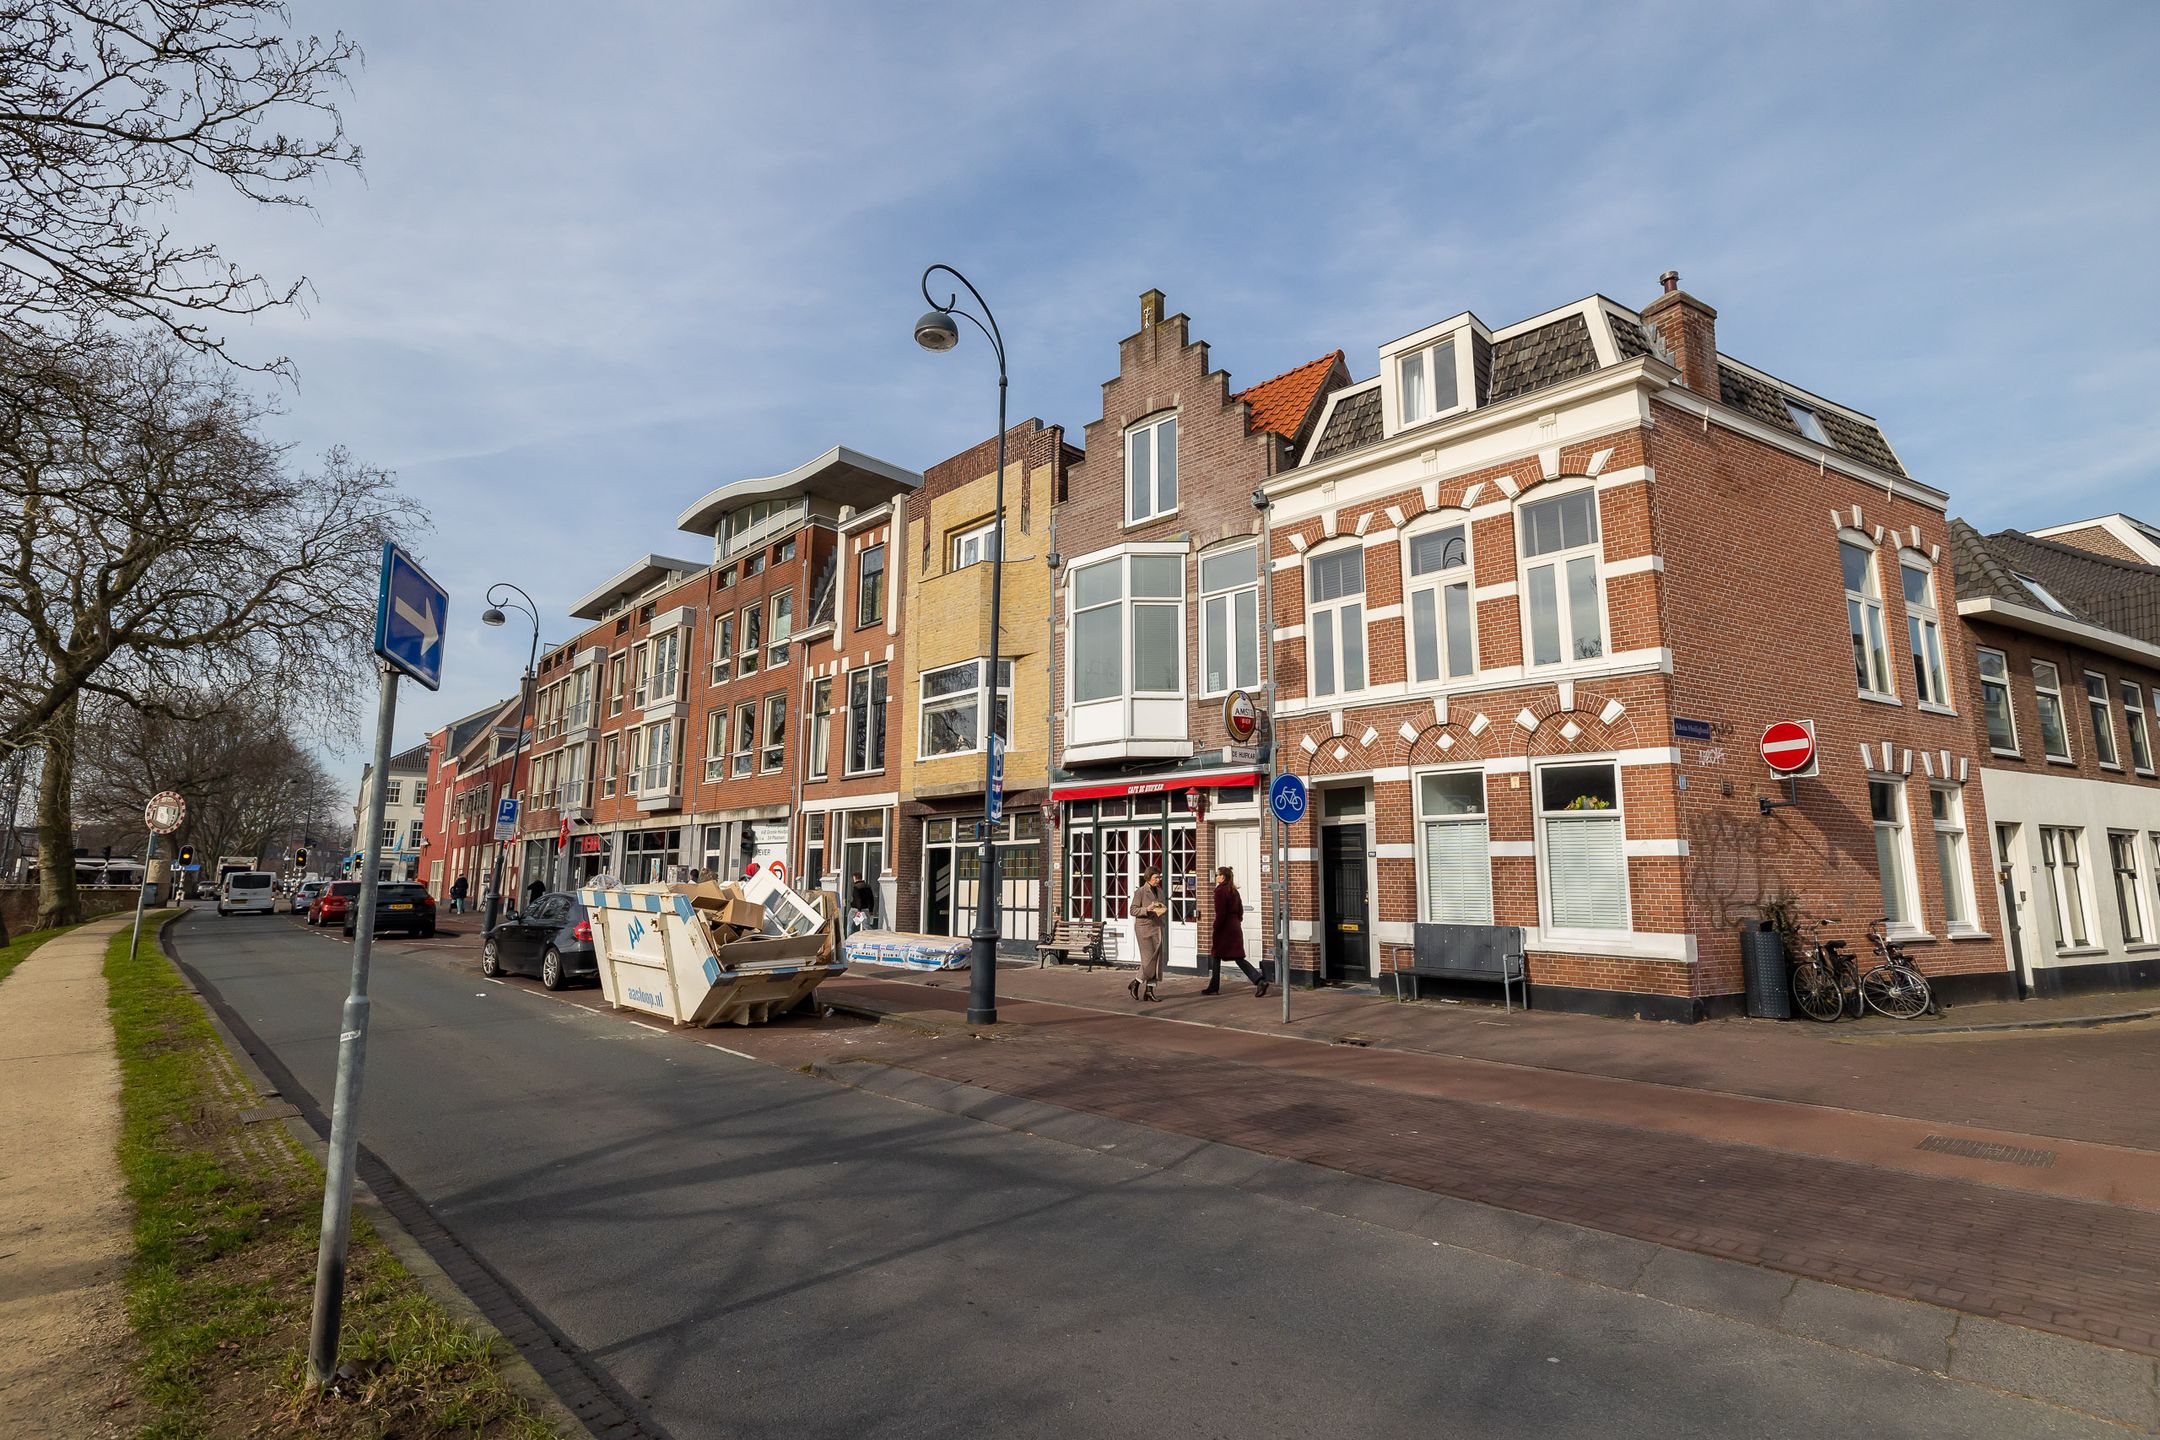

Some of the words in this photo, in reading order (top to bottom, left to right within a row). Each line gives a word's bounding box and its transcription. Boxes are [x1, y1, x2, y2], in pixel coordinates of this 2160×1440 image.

[503, 801, 513, 814] P
[628, 915, 645, 950] AA
[628, 986, 664, 1009] aasloop.nl
